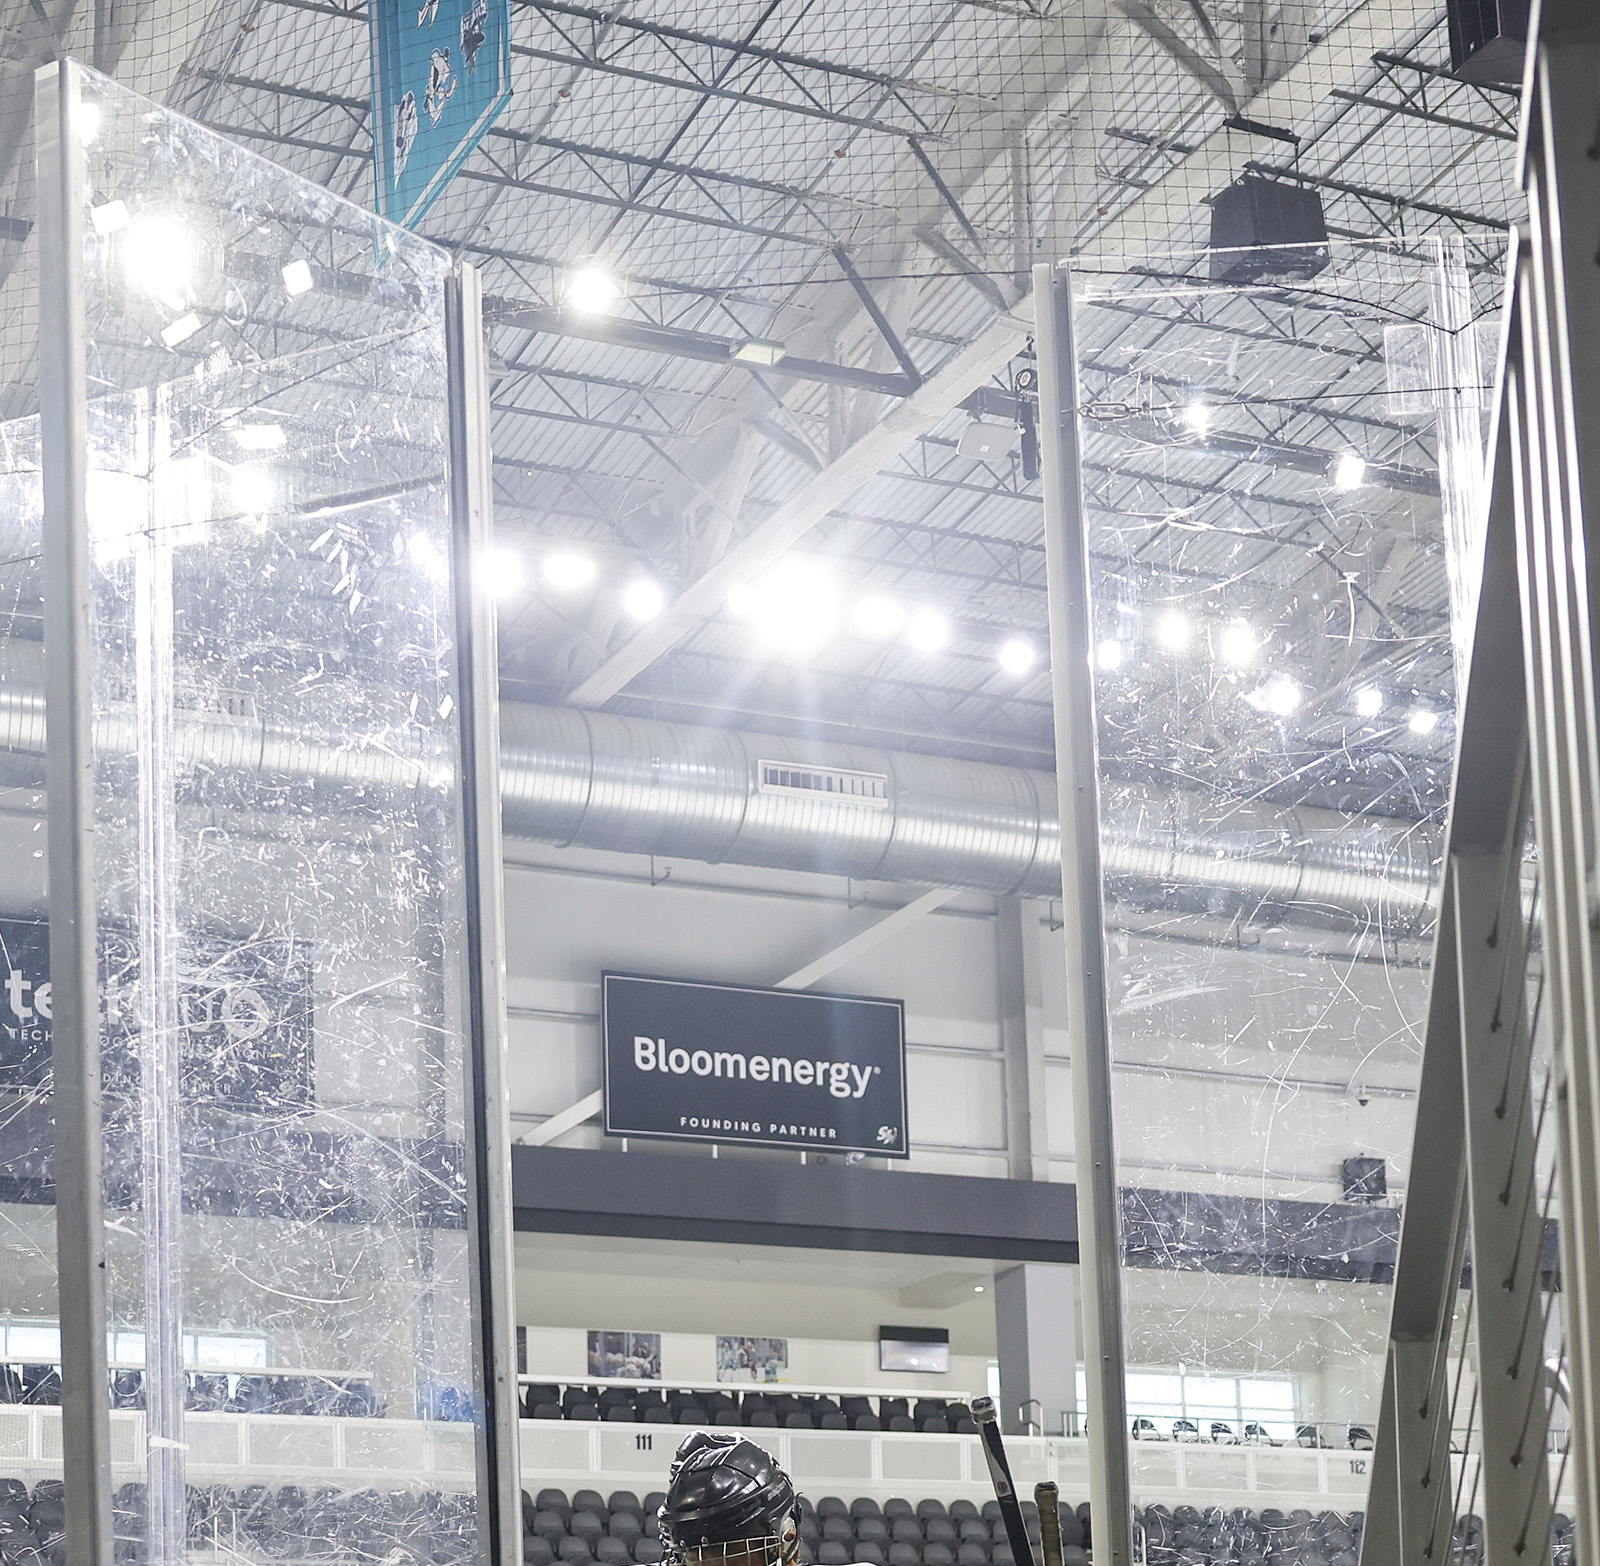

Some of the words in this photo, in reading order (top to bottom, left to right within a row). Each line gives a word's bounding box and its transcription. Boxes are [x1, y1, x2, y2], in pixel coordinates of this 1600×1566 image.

[634, 1035, 873, 1099] Bloomenergy
[680, 1116, 761, 1133] FOUNDING
[769, 1123, 837, 1139] PARTNER
[635, 1433, 652, 1450] 111
[1350, 1459, 1367, 1474] 112
